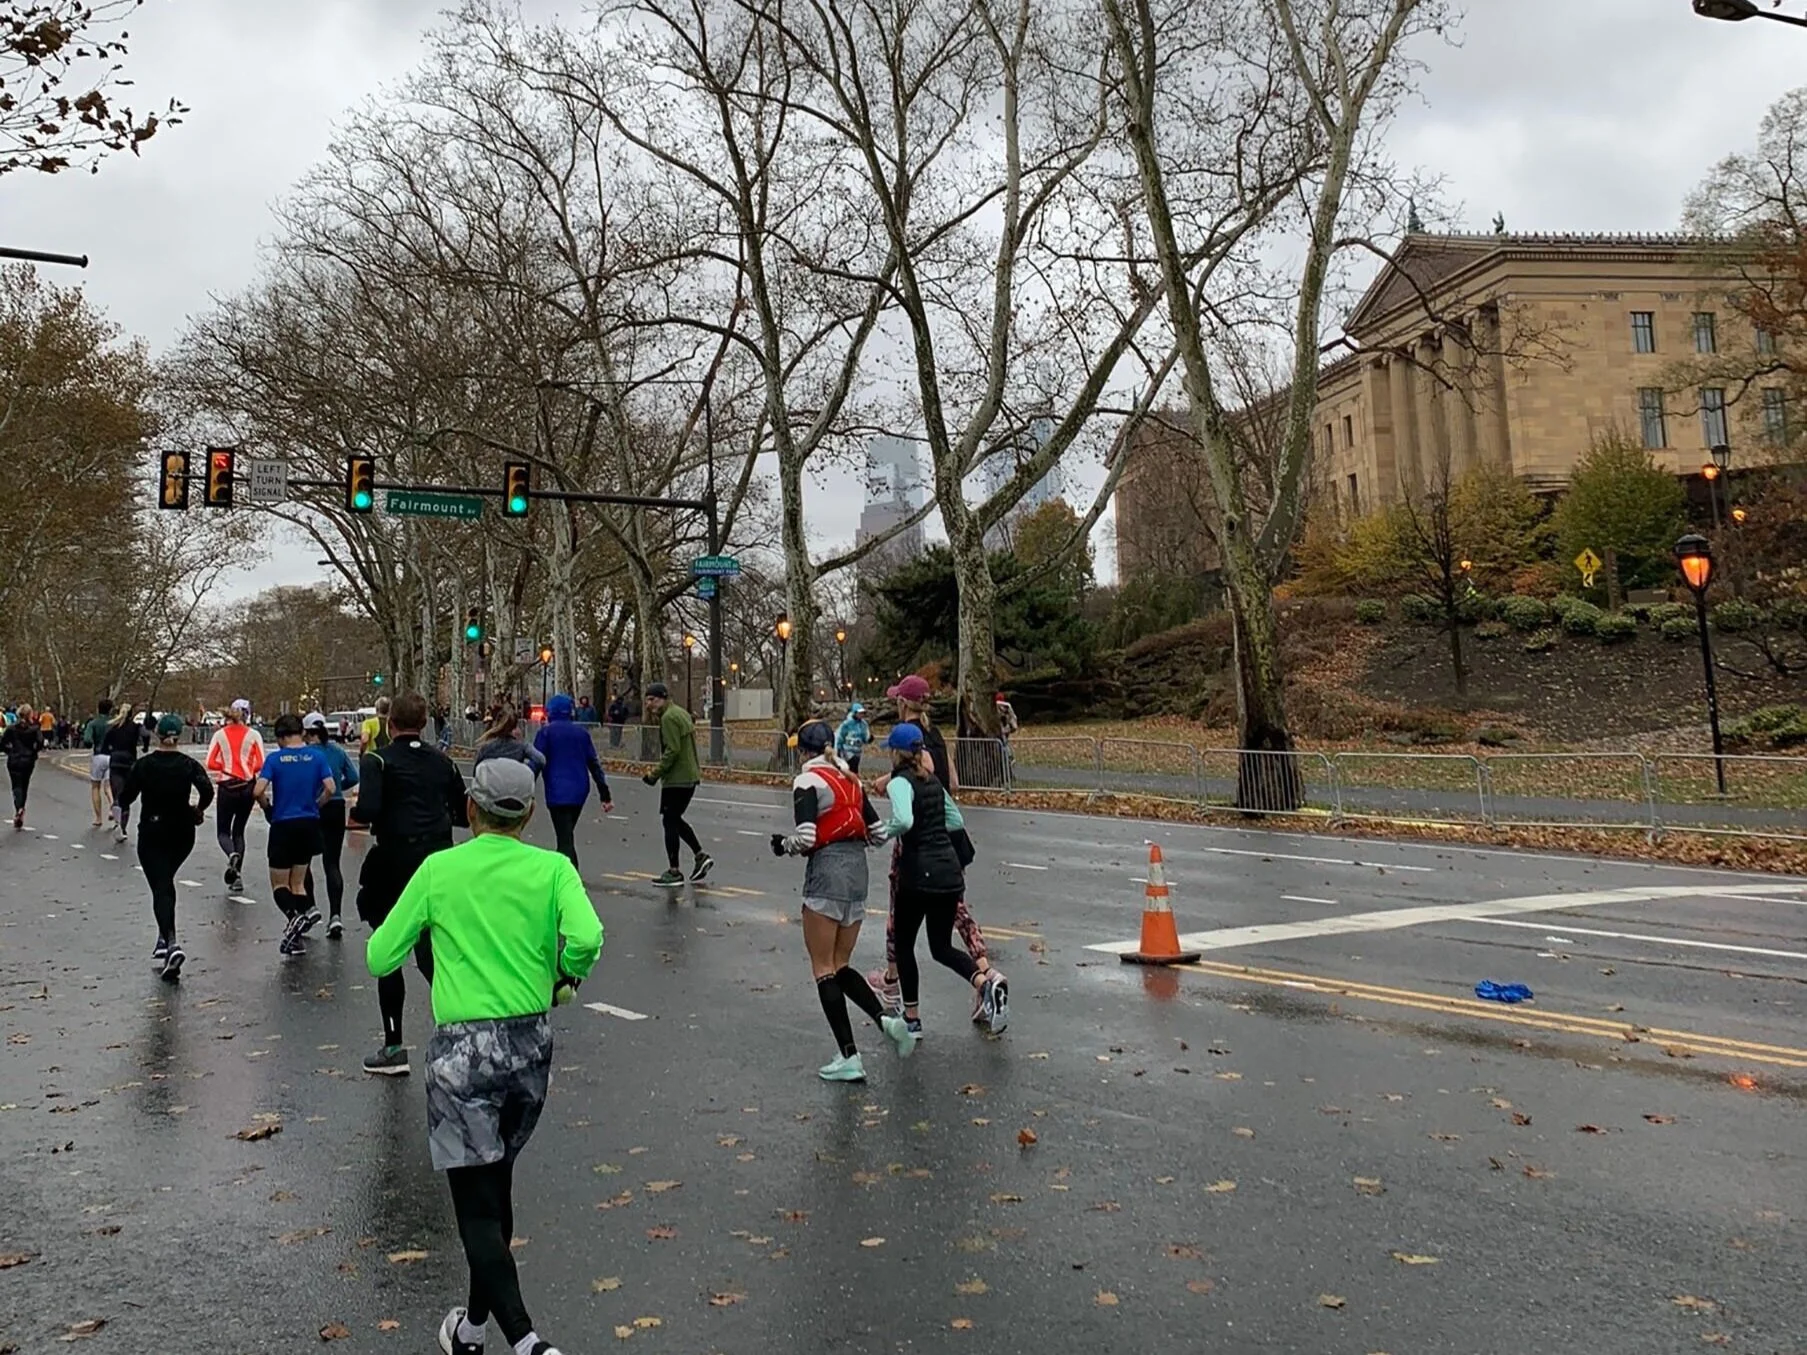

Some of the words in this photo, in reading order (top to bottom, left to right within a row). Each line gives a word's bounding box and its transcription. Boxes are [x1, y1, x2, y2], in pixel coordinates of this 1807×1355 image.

[257, 464, 281, 473] LEFT
[256, 475, 281, 484] TURN
[253, 487, 282, 496] SIGNAL
[390, 498, 464, 514] Fairmount
